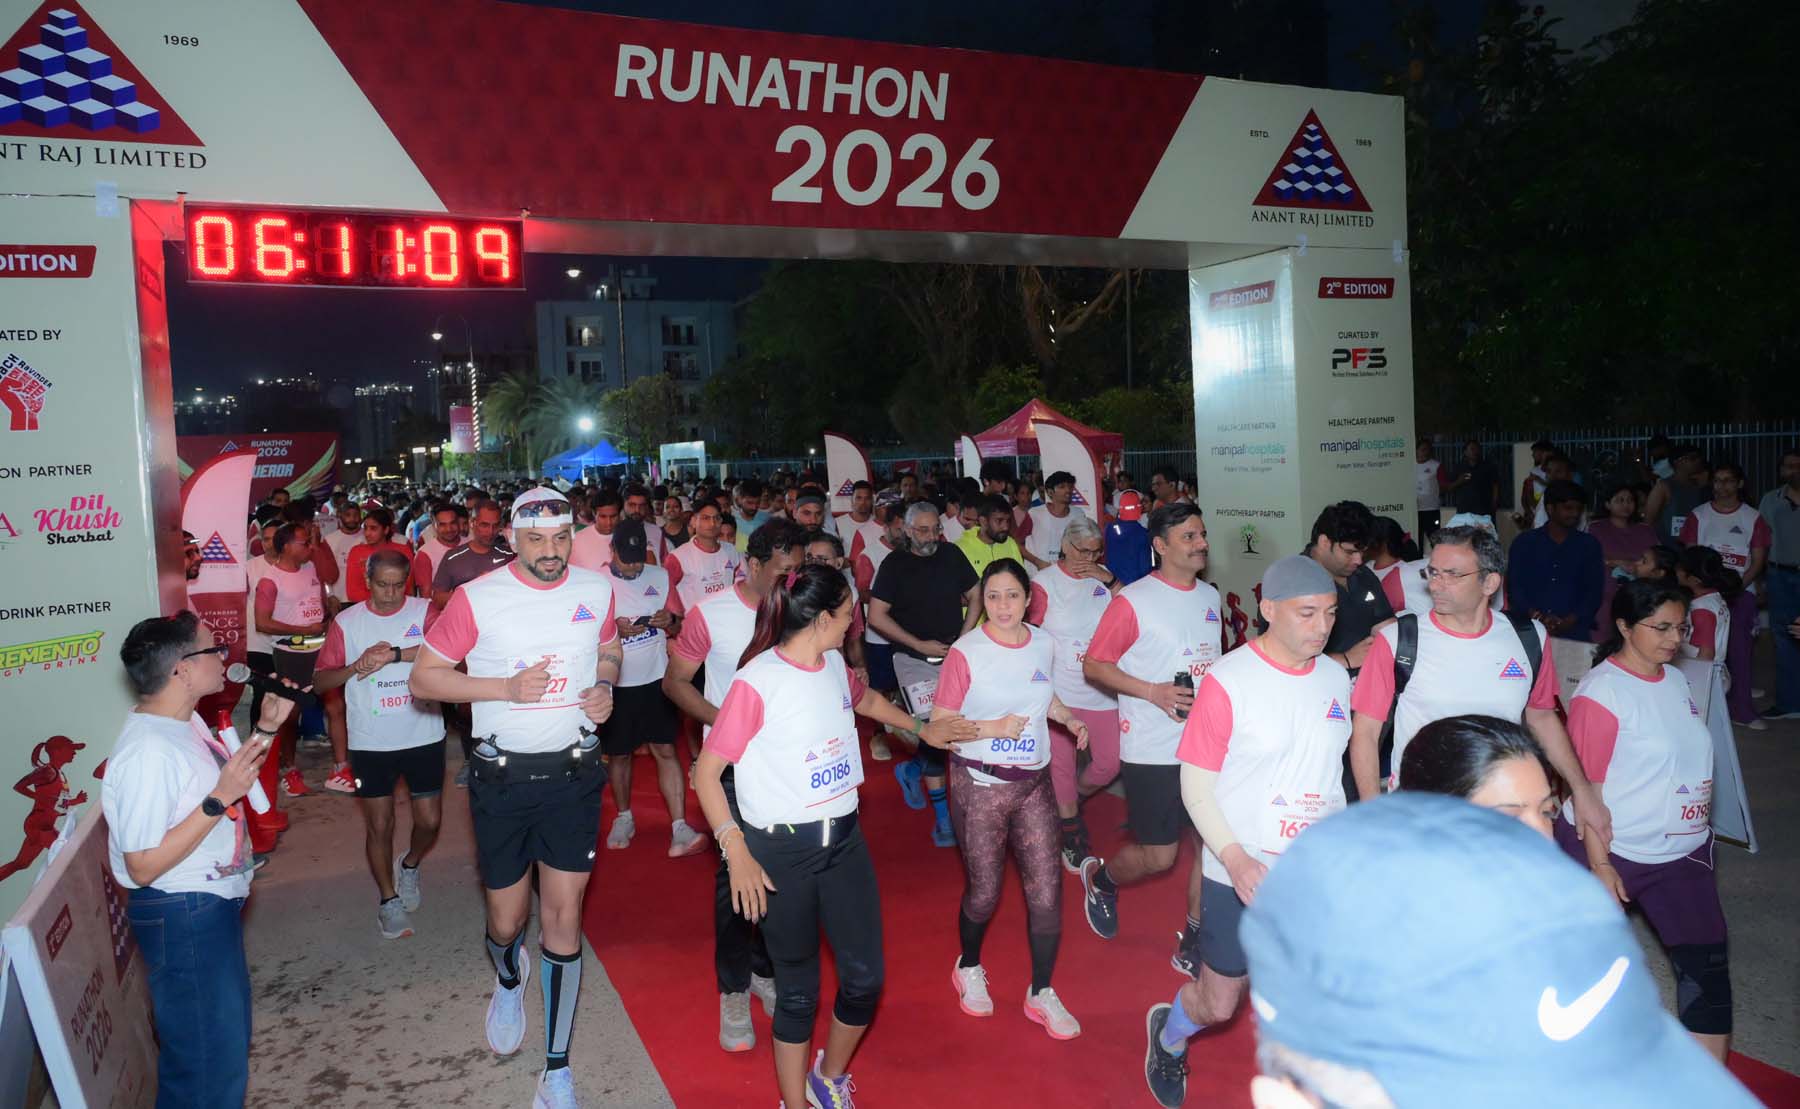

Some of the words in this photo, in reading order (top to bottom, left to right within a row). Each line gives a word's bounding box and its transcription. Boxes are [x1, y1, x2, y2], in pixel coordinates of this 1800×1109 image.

[163, 35, 199, 46] 1969
[614, 43, 949, 121] RUNATHON
[39, 145, 82, 167] RAJ
[94, 147, 207, 169] LIMITED
[771, 124, 1001, 211] 2026
[1251, 210, 1295, 224] ANANT
[1300, 212, 1319, 227] RAJ
[1324, 214, 1374, 228] LIMITED
[1344, 283, 1387, 295] EDITION
[43, 329, 61, 341] BY
[1337, 331, 1369, 340] CURATED
[1370, 330, 1380, 339] BY
[1332, 347, 1388, 370] PFS
[1328, 419, 1367, 427] HEALTHCARE
[1368, 416, 1395, 425] PARTNER
[258, 447, 288, 457] 2026
[29, 464, 92, 477] PARTNER
[70, 494, 104, 511] Dil
[1377, 504, 1404, 513] PARTNER
[33, 506, 123, 532] Khush
[46, 530, 114, 545] Sharbat
[0, 606, 45, 620] DRINK
[49, 601, 111, 616] PARTNER
[43, 655, 97, 671] DRINK
[991, 738, 1035, 752] 80142
[811, 760, 851, 789] 80186
